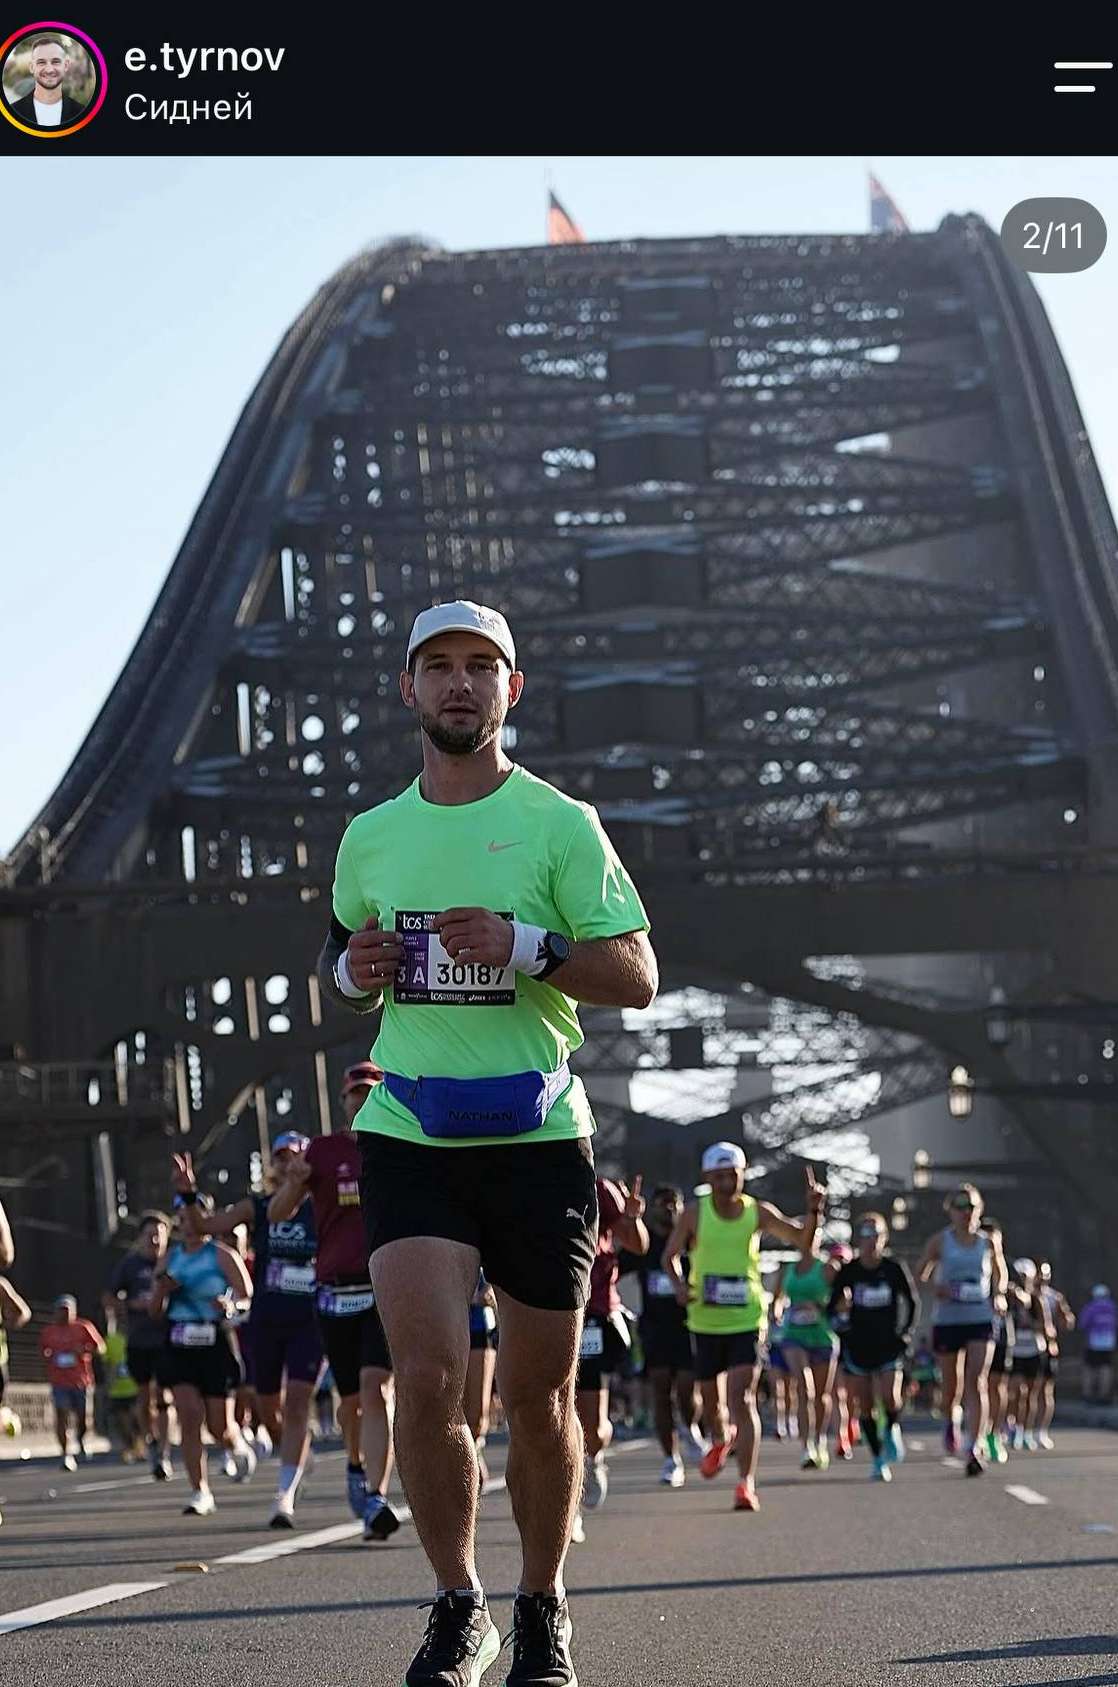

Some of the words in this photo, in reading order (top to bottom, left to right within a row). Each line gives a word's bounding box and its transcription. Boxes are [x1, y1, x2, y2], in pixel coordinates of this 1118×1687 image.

[402, 913, 422, 930] tcs
[413, 966, 426, 984] A
[437, 962, 505, 986] 30187
[449, 1110, 512, 1122] NATHAN
